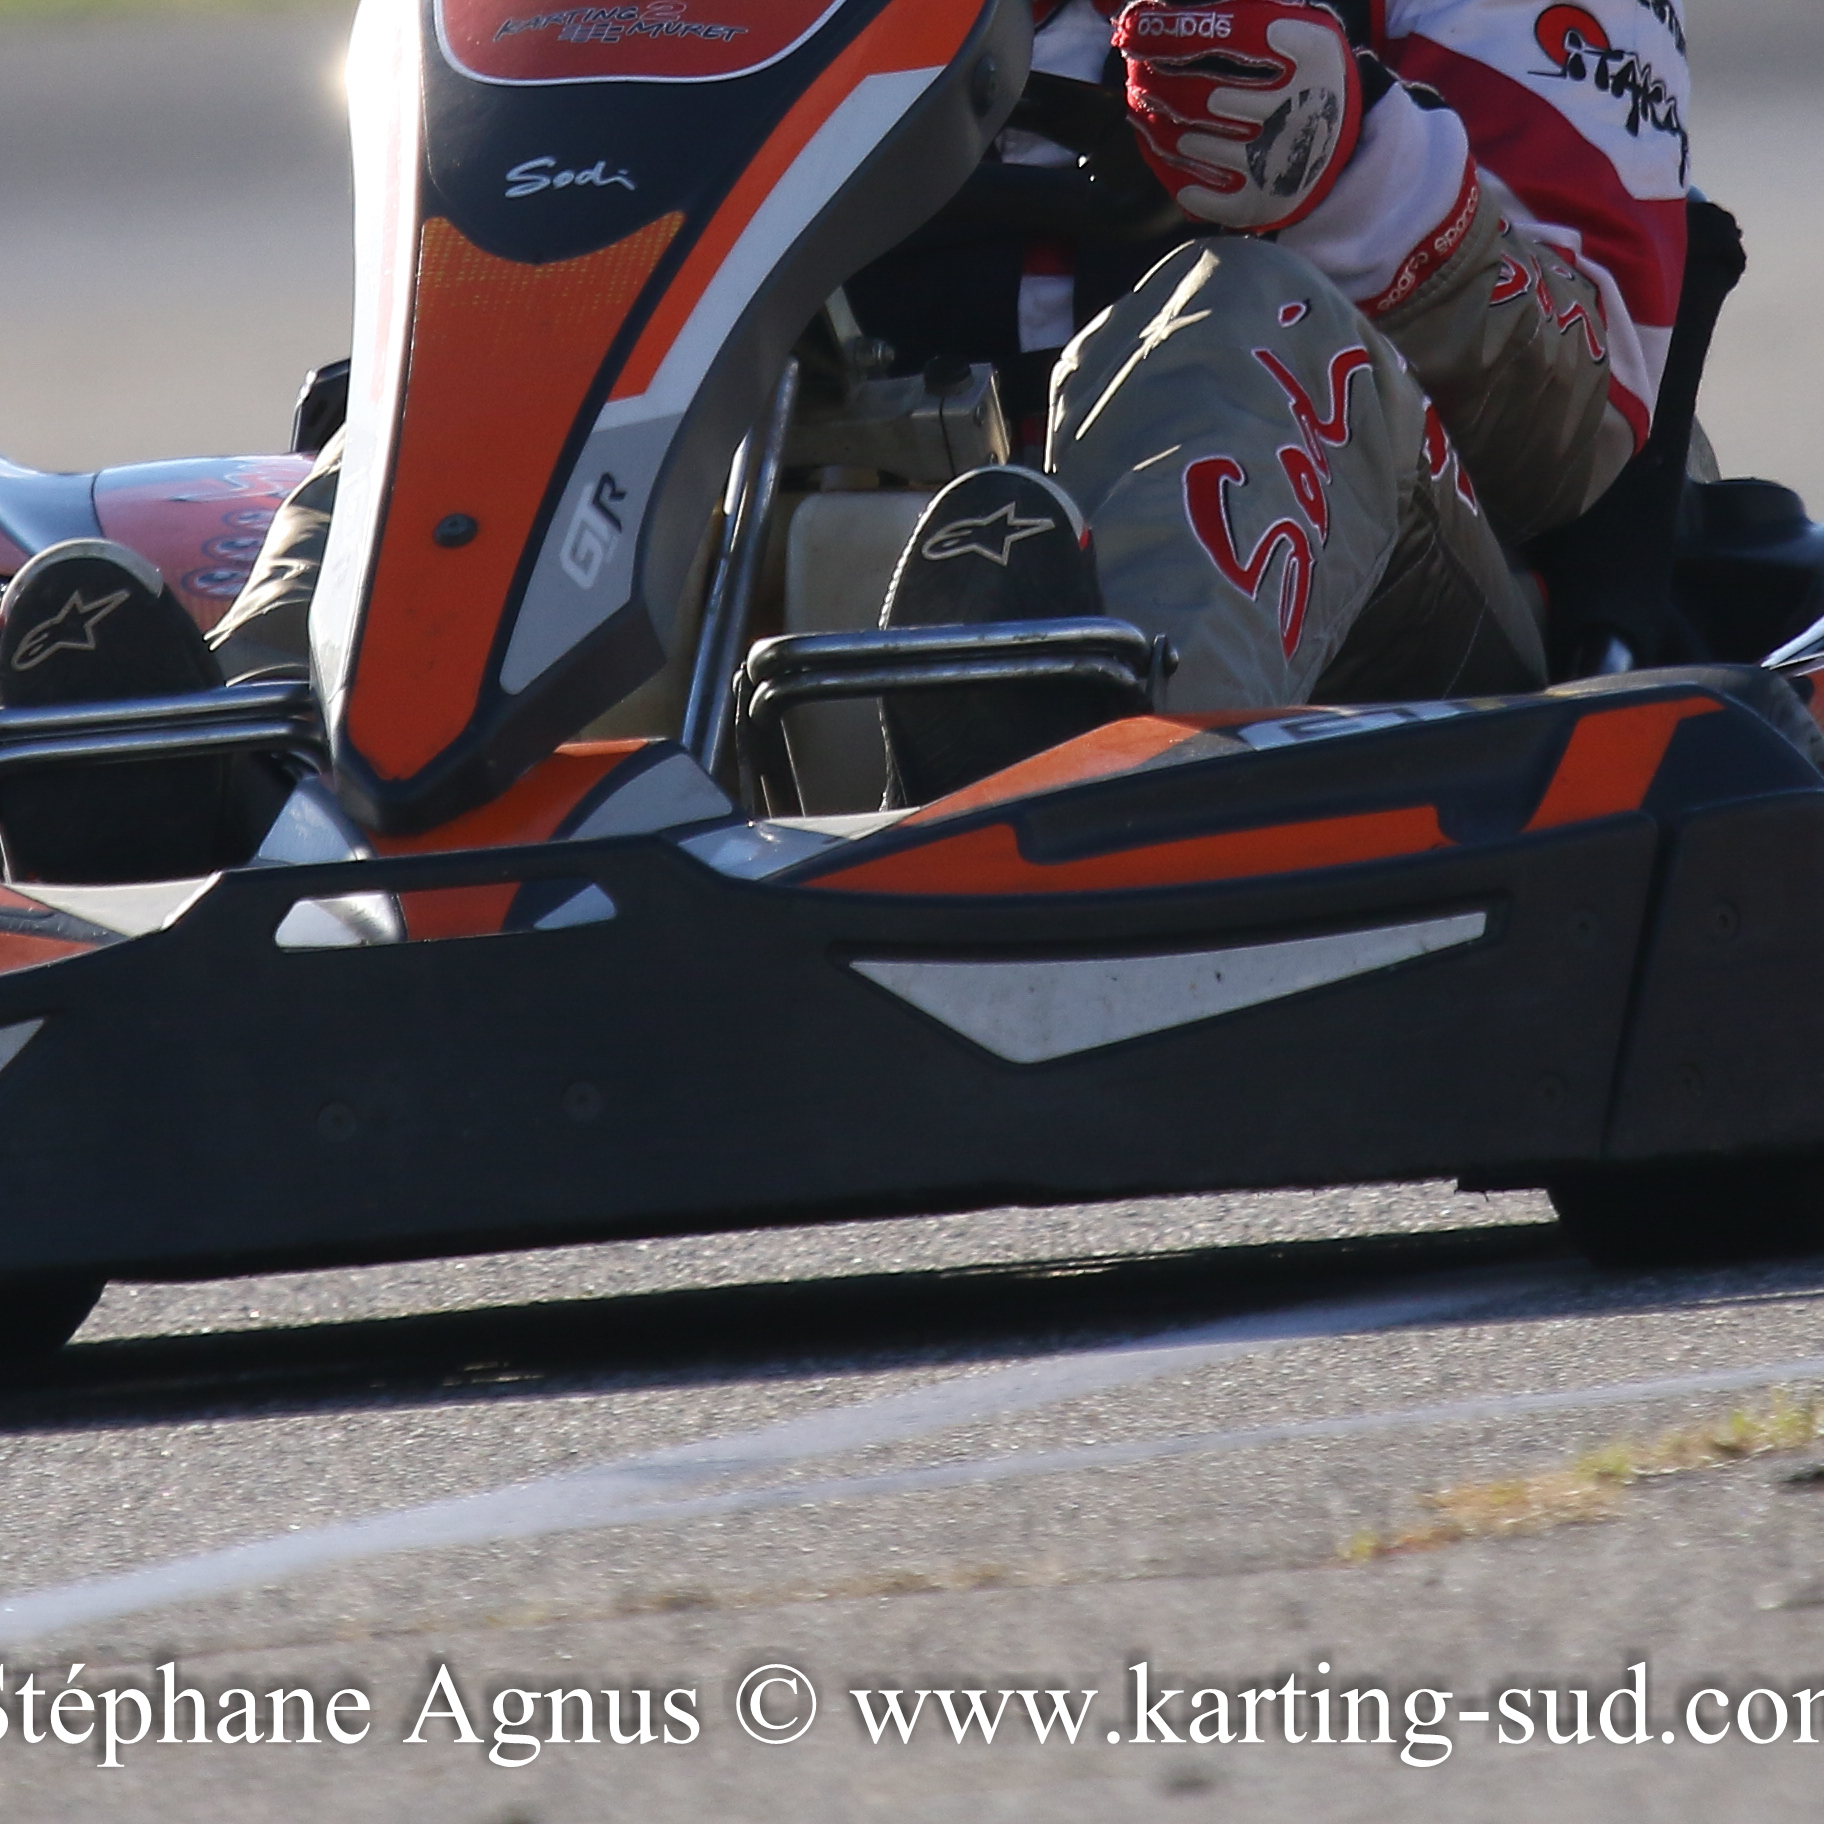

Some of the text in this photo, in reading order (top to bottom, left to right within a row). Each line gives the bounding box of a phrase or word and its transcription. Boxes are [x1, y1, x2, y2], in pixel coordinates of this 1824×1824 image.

[493, 6, 639, 43] KARTING
[627, 21, 749, 43] MURET
[1138, 11, 1233, 39] sparco
[504, 155, 636, 199] Sodi
